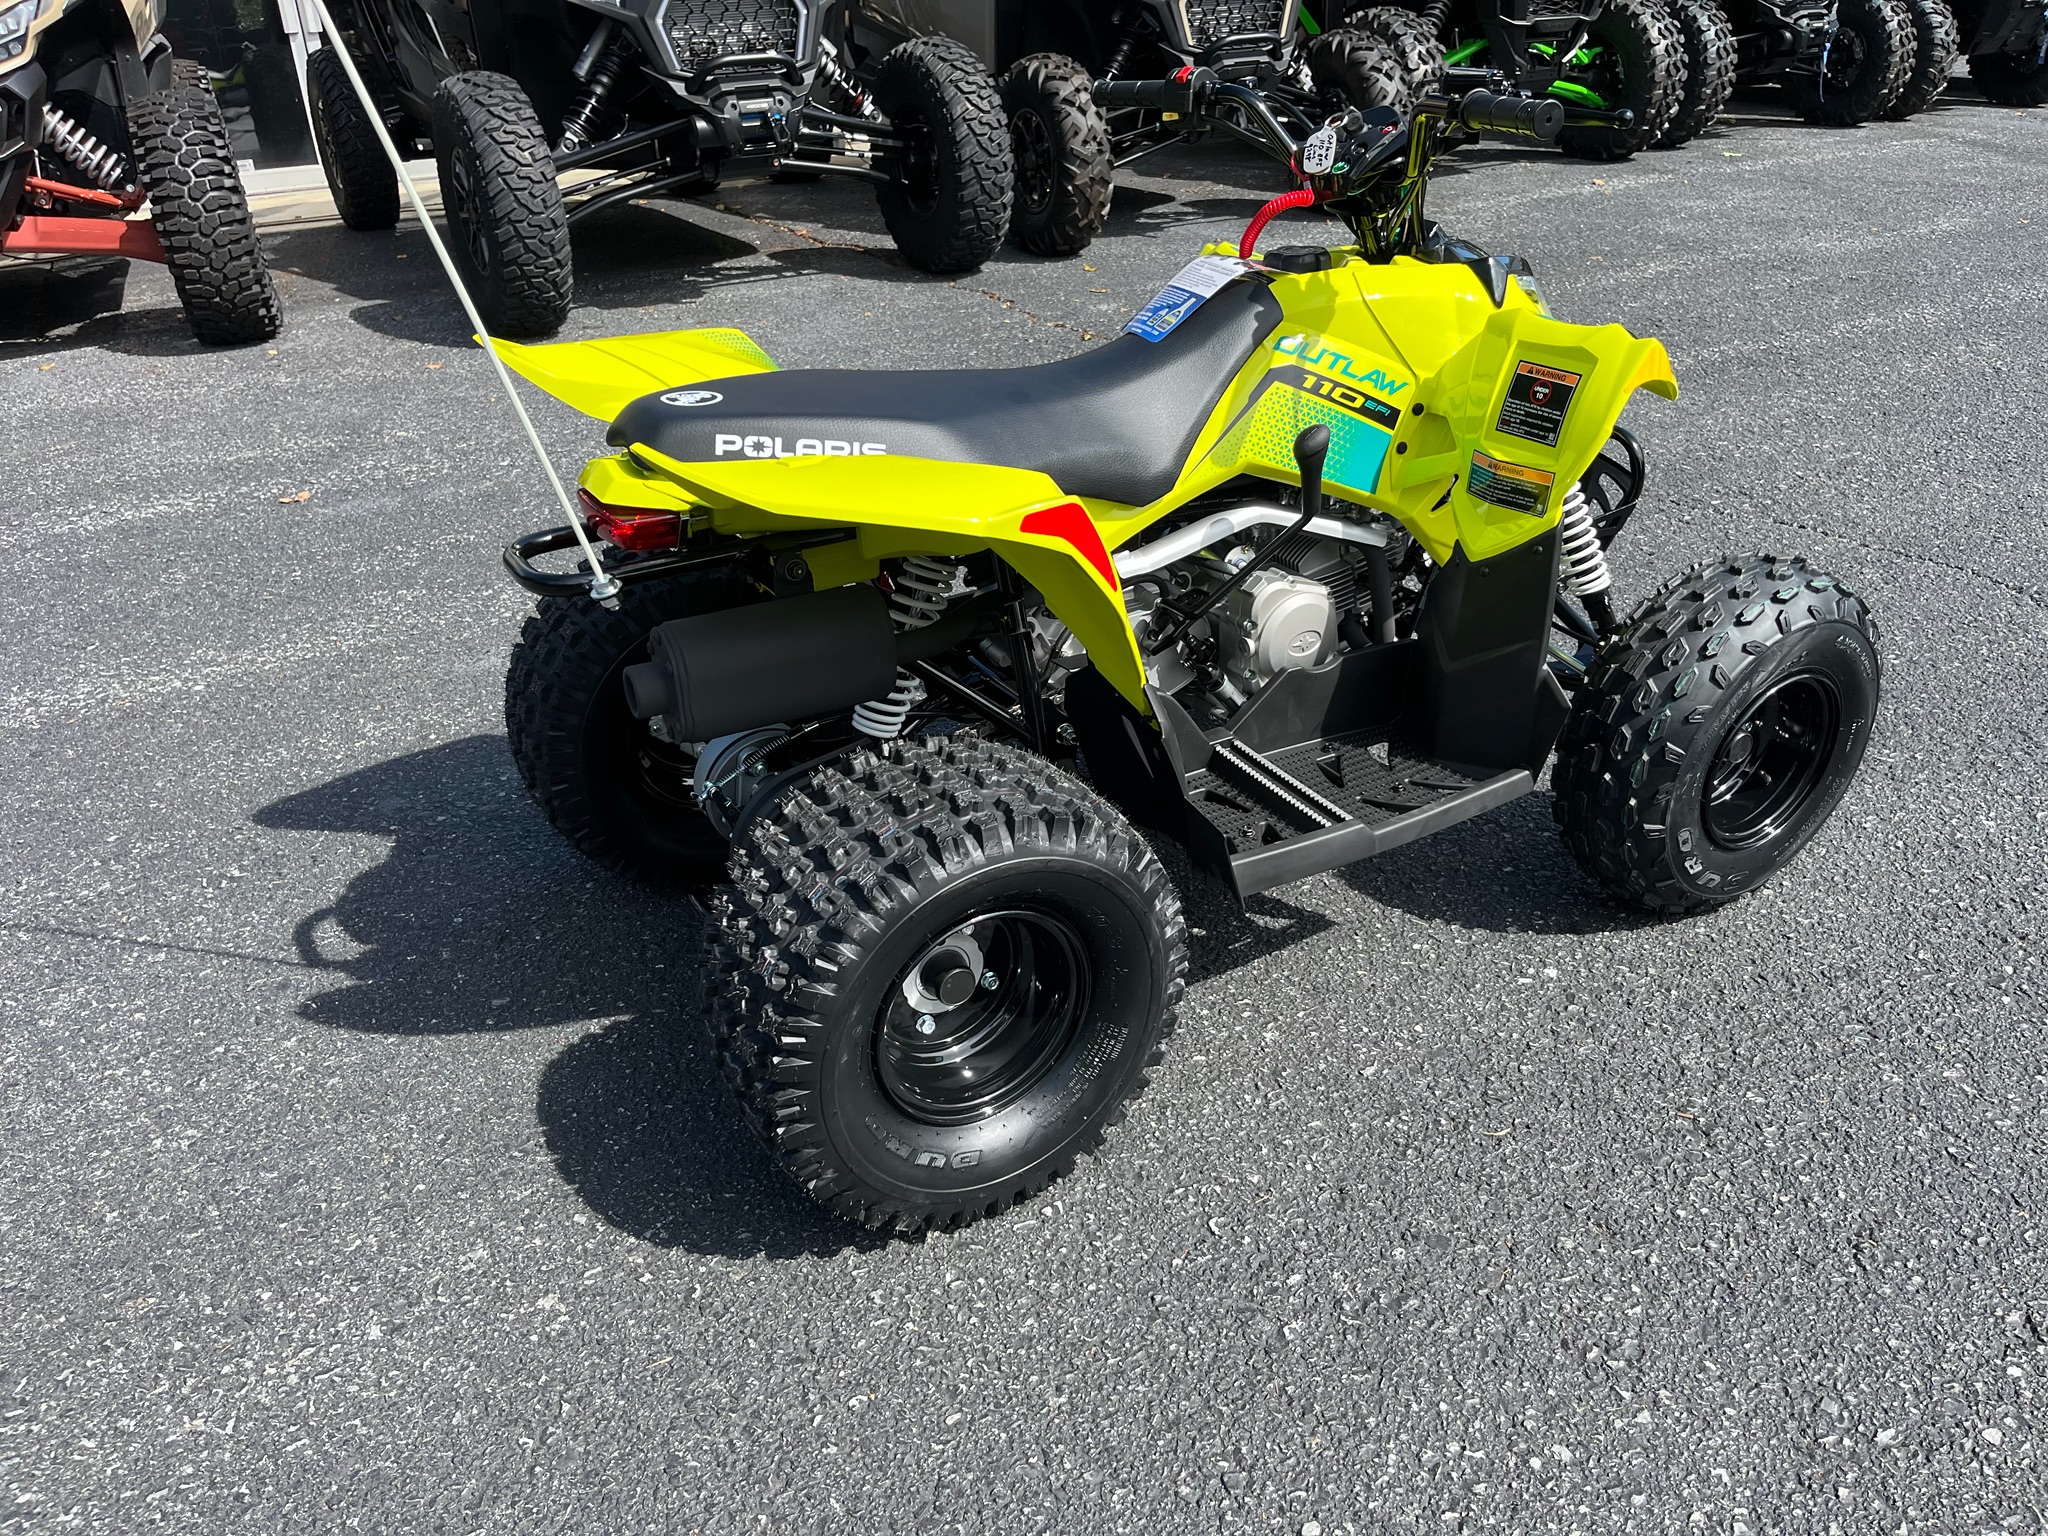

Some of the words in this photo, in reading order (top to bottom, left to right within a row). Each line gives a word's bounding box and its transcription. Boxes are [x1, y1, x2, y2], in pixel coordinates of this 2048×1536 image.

[1273, 336, 1408, 396] OUTLAW
[1534, 367, 1566, 382] WARNING
[1302, 374, 1365, 408] 110
[1364, 400, 1390, 416] EFI
[715, 434, 887, 458] POLARIS
[1493, 463, 1524, 476] WARNING
